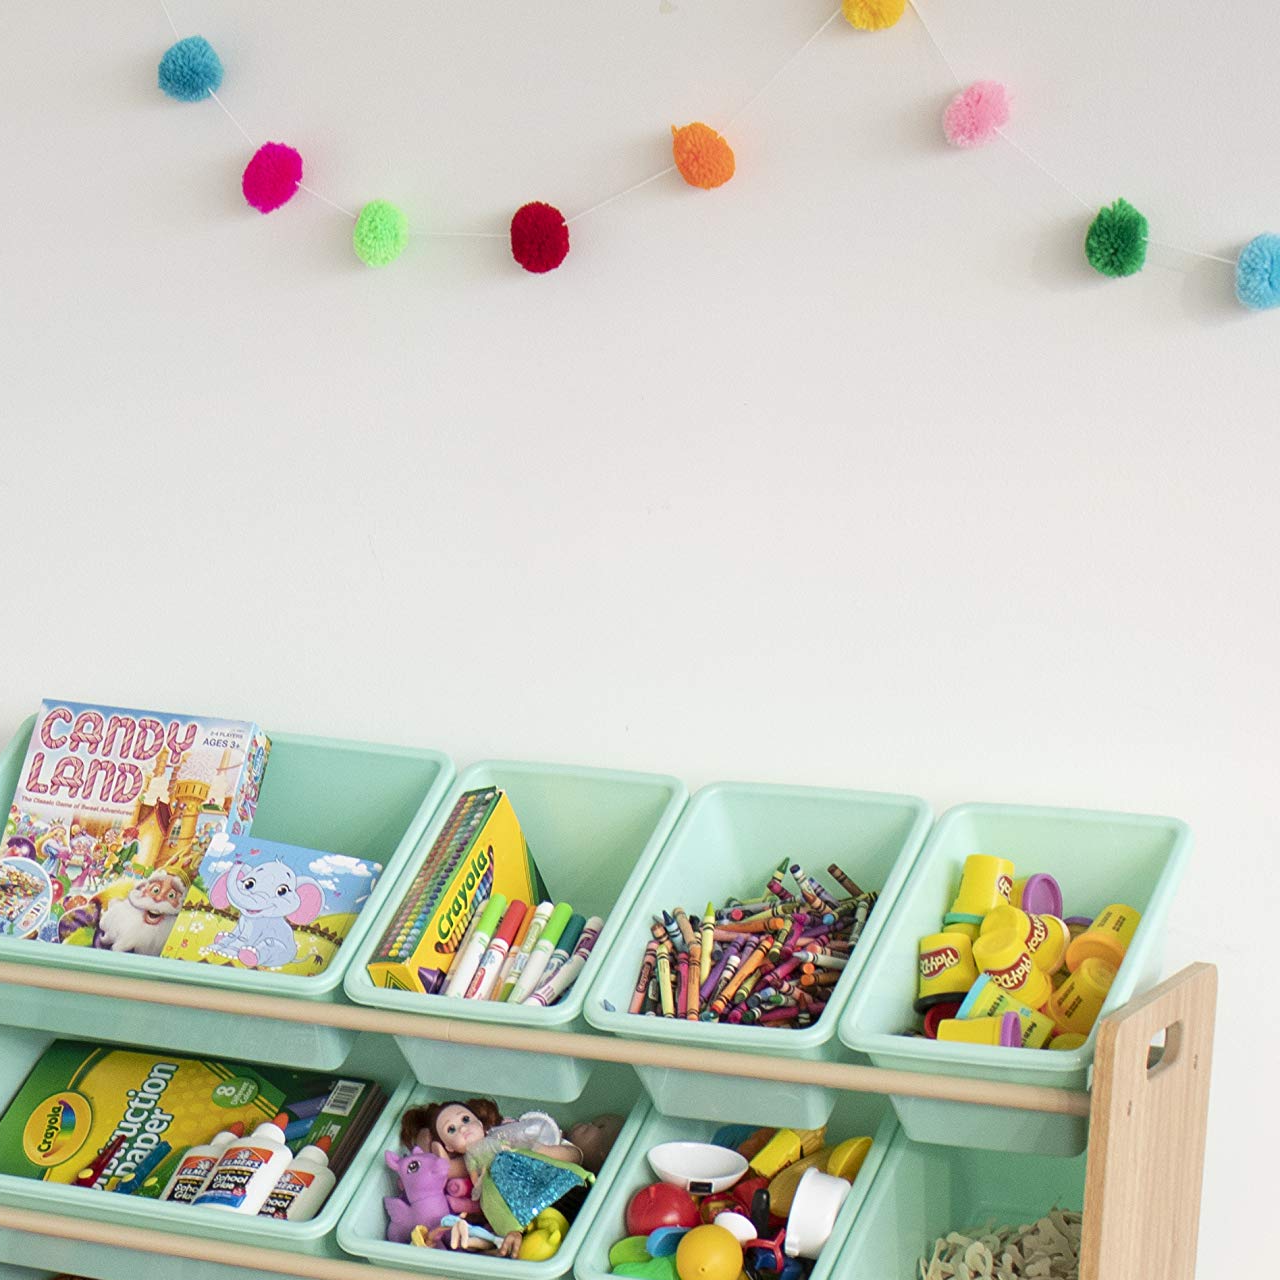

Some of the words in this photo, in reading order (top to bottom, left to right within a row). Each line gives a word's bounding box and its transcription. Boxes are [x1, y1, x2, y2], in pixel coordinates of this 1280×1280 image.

[40, 707, 198, 765] CANDY
[203, 738, 228, 748] AGES
[230, 741, 240, 749] 3+
[25, 751, 144, 804] LAND
[437, 850, 488, 940] Crayola
[216, 1085, 236, 1097] 8
[37, 1105, 62, 1153] Crayola
[114, 1107, 174, 1177] paper
